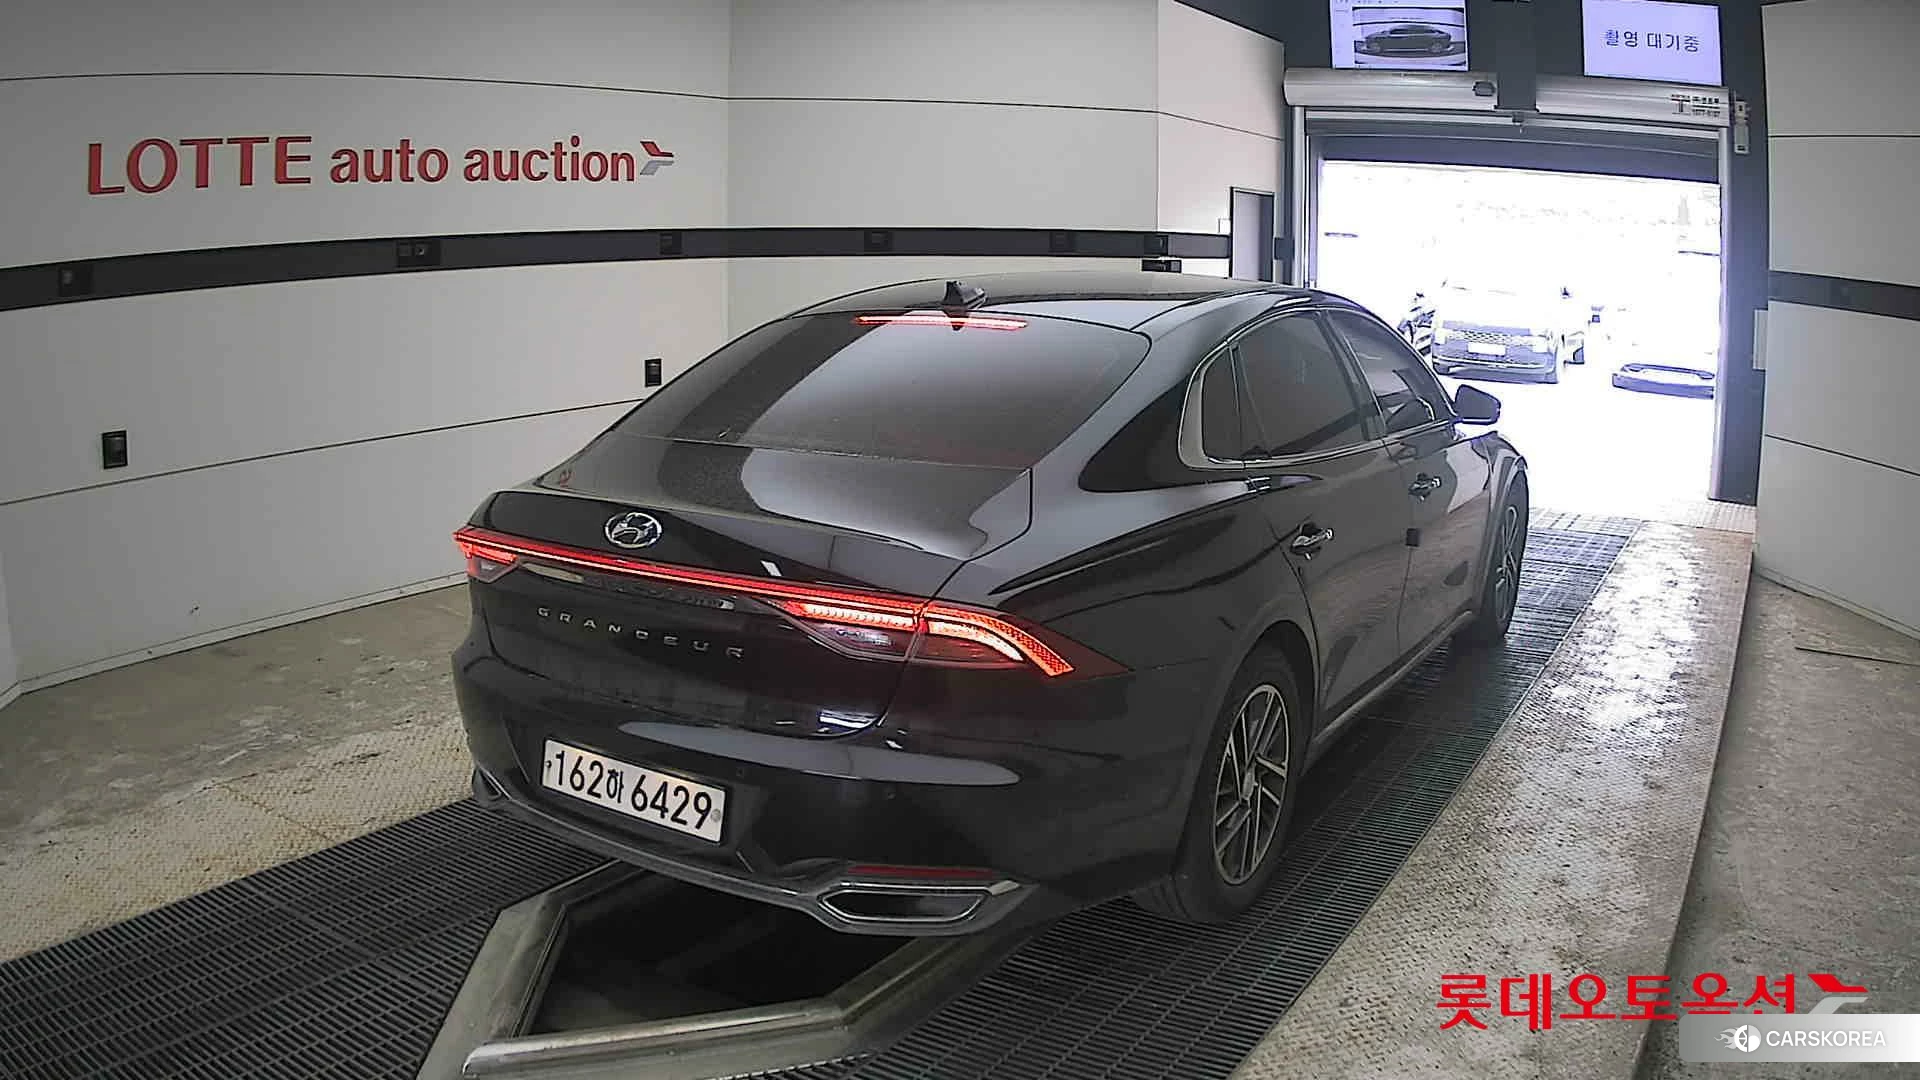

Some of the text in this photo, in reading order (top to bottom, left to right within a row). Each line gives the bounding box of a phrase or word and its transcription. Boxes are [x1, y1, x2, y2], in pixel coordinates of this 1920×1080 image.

[1605, 29, 1700, 53] 촬영 대기중
[88, 135, 636, 194] LOTTE auto auction
[537, 605, 744, 661] GRANDEUR
[555, 749, 713, 830] 162하 6429
